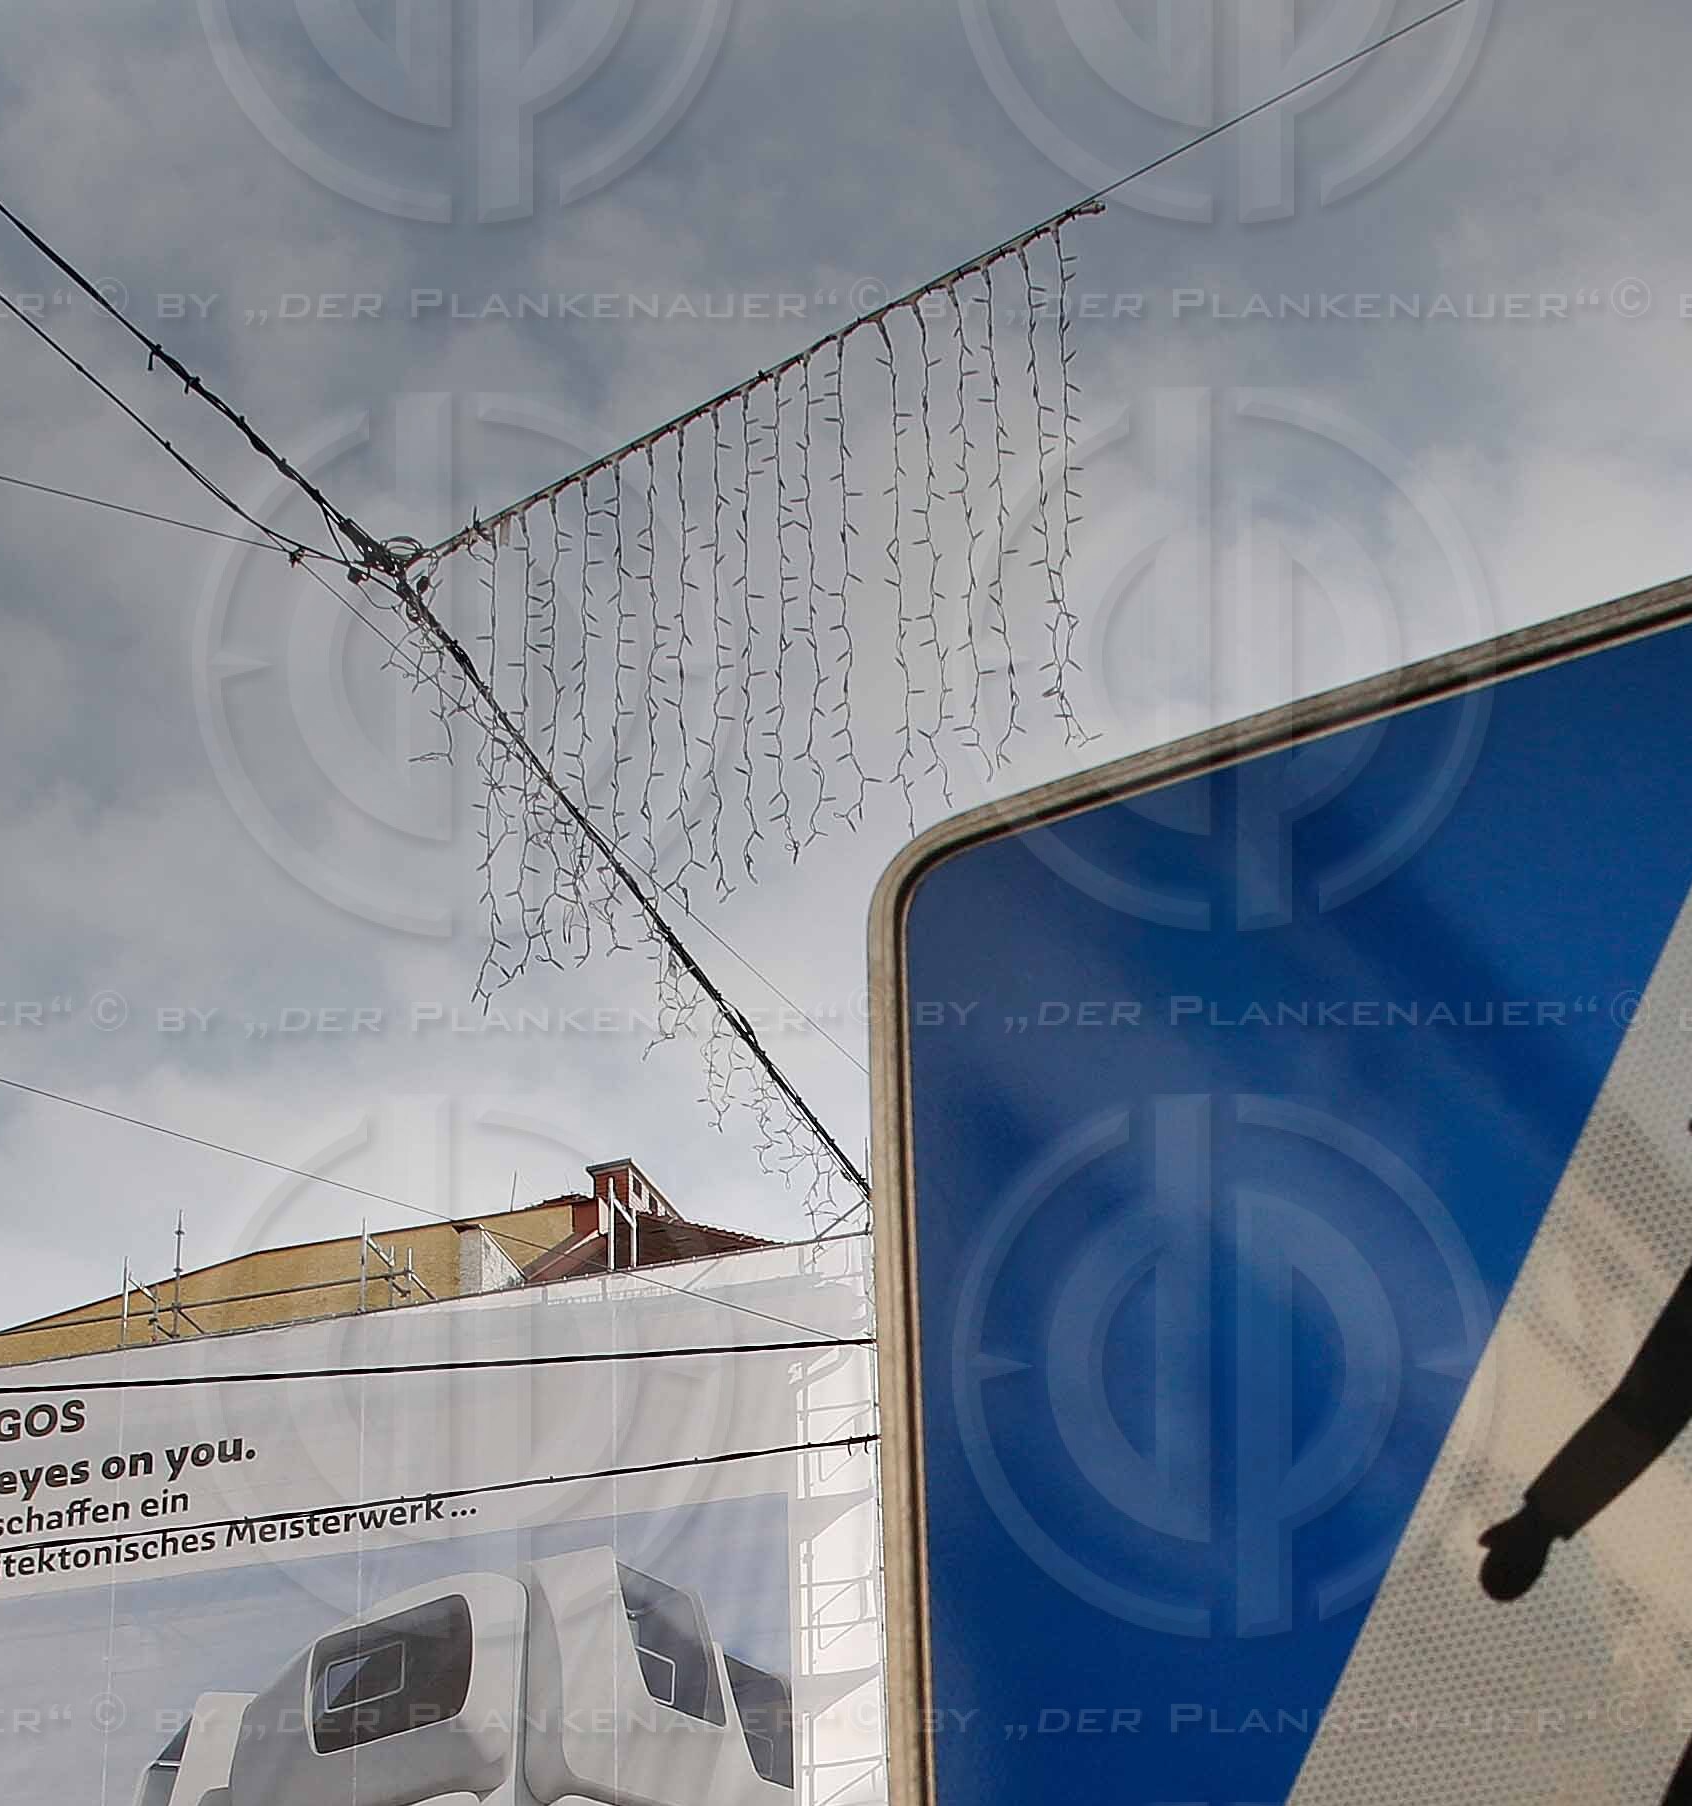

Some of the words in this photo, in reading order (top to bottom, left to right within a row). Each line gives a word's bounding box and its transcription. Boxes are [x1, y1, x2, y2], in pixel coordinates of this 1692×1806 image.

[102, 1450, 153, 1479] on
[165, 1438, 257, 1482] you.
[141, 1489, 189, 1518] ein
